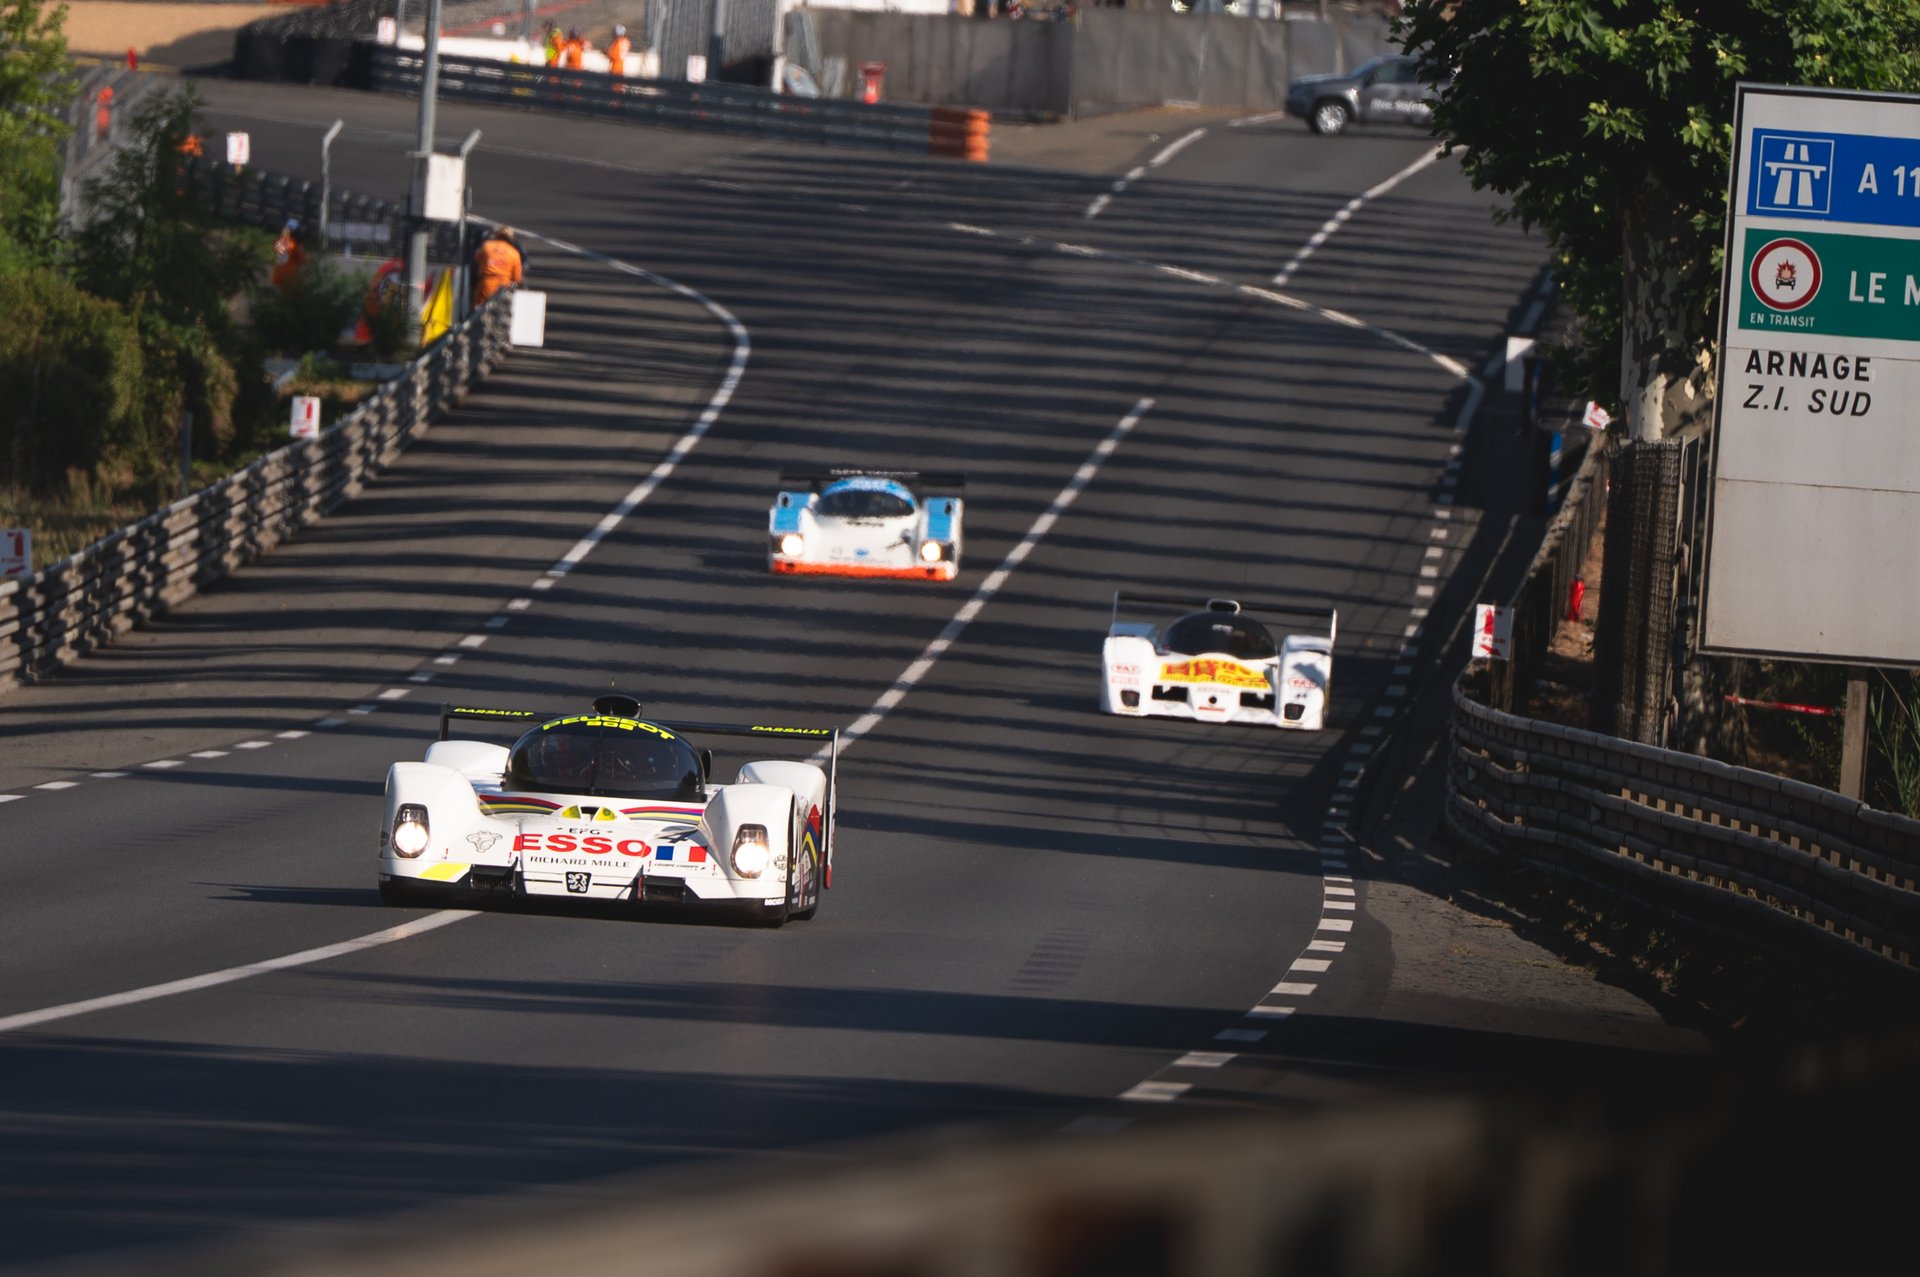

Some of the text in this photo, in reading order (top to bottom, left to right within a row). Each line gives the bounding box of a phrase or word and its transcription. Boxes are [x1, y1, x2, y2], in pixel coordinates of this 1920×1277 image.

[1857, 163, 1920, 197] A 11
[1849, 270, 1887, 304] LE
[1750, 312, 1815, 327] EN TRANSIT
[1745, 349, 1871, 382] ARNAGE
[1743, 384, 1872, 417] Z.I. SUD
[543, 715, 675, 740] PEUGEOT
[512, 834, 652, 857] ESSO
[530, 855, 630, 868] RICHARD MILLE
